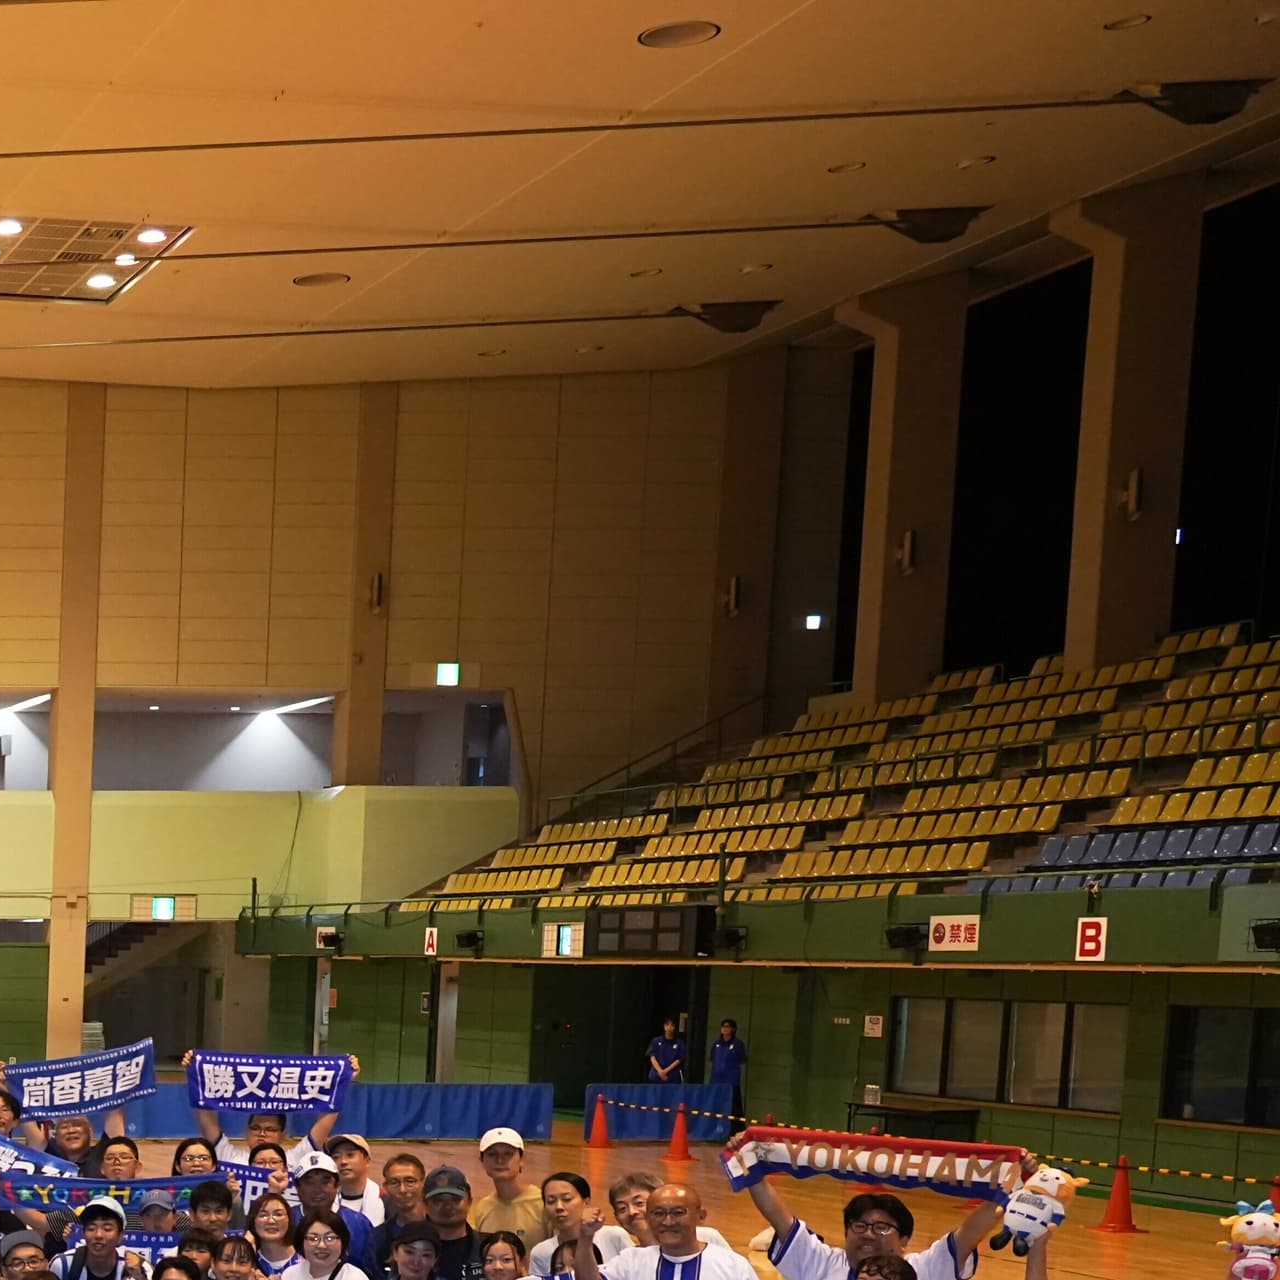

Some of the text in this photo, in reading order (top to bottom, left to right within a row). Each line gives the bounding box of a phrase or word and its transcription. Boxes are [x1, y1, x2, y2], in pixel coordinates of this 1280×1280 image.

[425, 930, 435, 953] A
[948, 923, 977, 943] 禁煙
[1079, 920, 1101, 957] B
[22, 1054, 145, 1108] 筒香嘉智
[202, 1063, 336, 1102] 勝又温史
[783, 1137, 1019, 1194] YOKOHAMA
